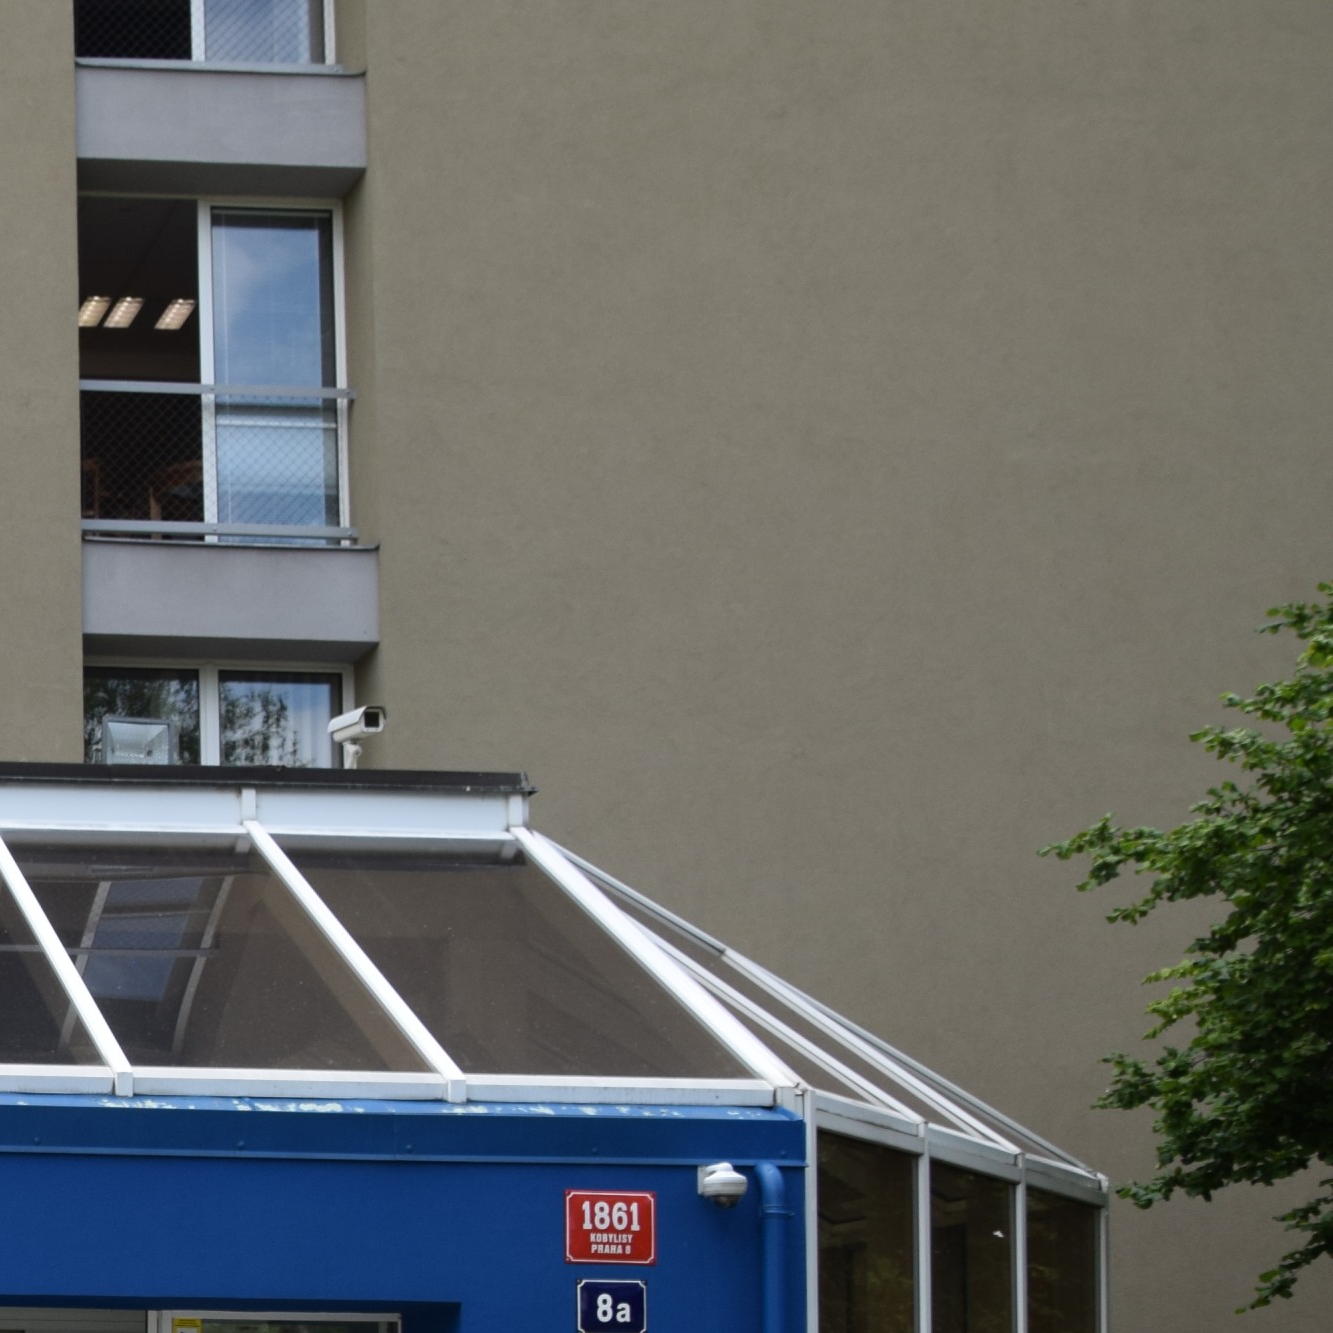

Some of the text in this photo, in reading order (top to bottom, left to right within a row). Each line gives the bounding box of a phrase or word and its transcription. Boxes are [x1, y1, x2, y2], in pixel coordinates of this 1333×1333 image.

[582, 1201, 640, 1231] 1861
[591, 1233, 633, 1243] KOBYLISY
[591, 1244, 622, 1254] PRAHA
[597, 1294, 631, 1322] 8a
